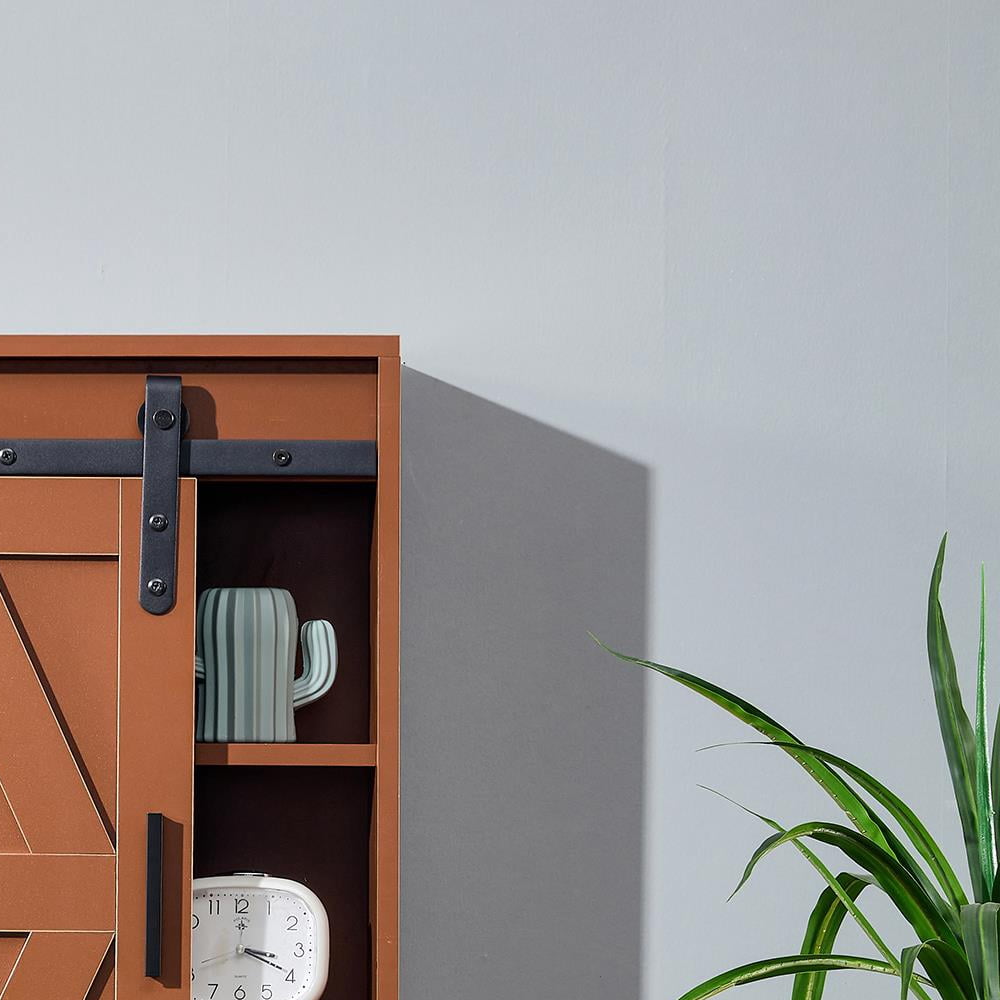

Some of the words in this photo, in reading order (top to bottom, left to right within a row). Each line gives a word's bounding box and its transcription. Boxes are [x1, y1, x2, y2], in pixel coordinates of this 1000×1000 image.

[208, 899, 220, 915] 11
[234, 898, 250, 914] 12
[286, 915, 299, 931] 2
[293, 942, 305, 958] 3
[284, 968, 296, 984] 4
[207, 983, 219, 1000] 7
[233, 984, 246, 1000] 6
[260, 984, 273, 1000] 5
